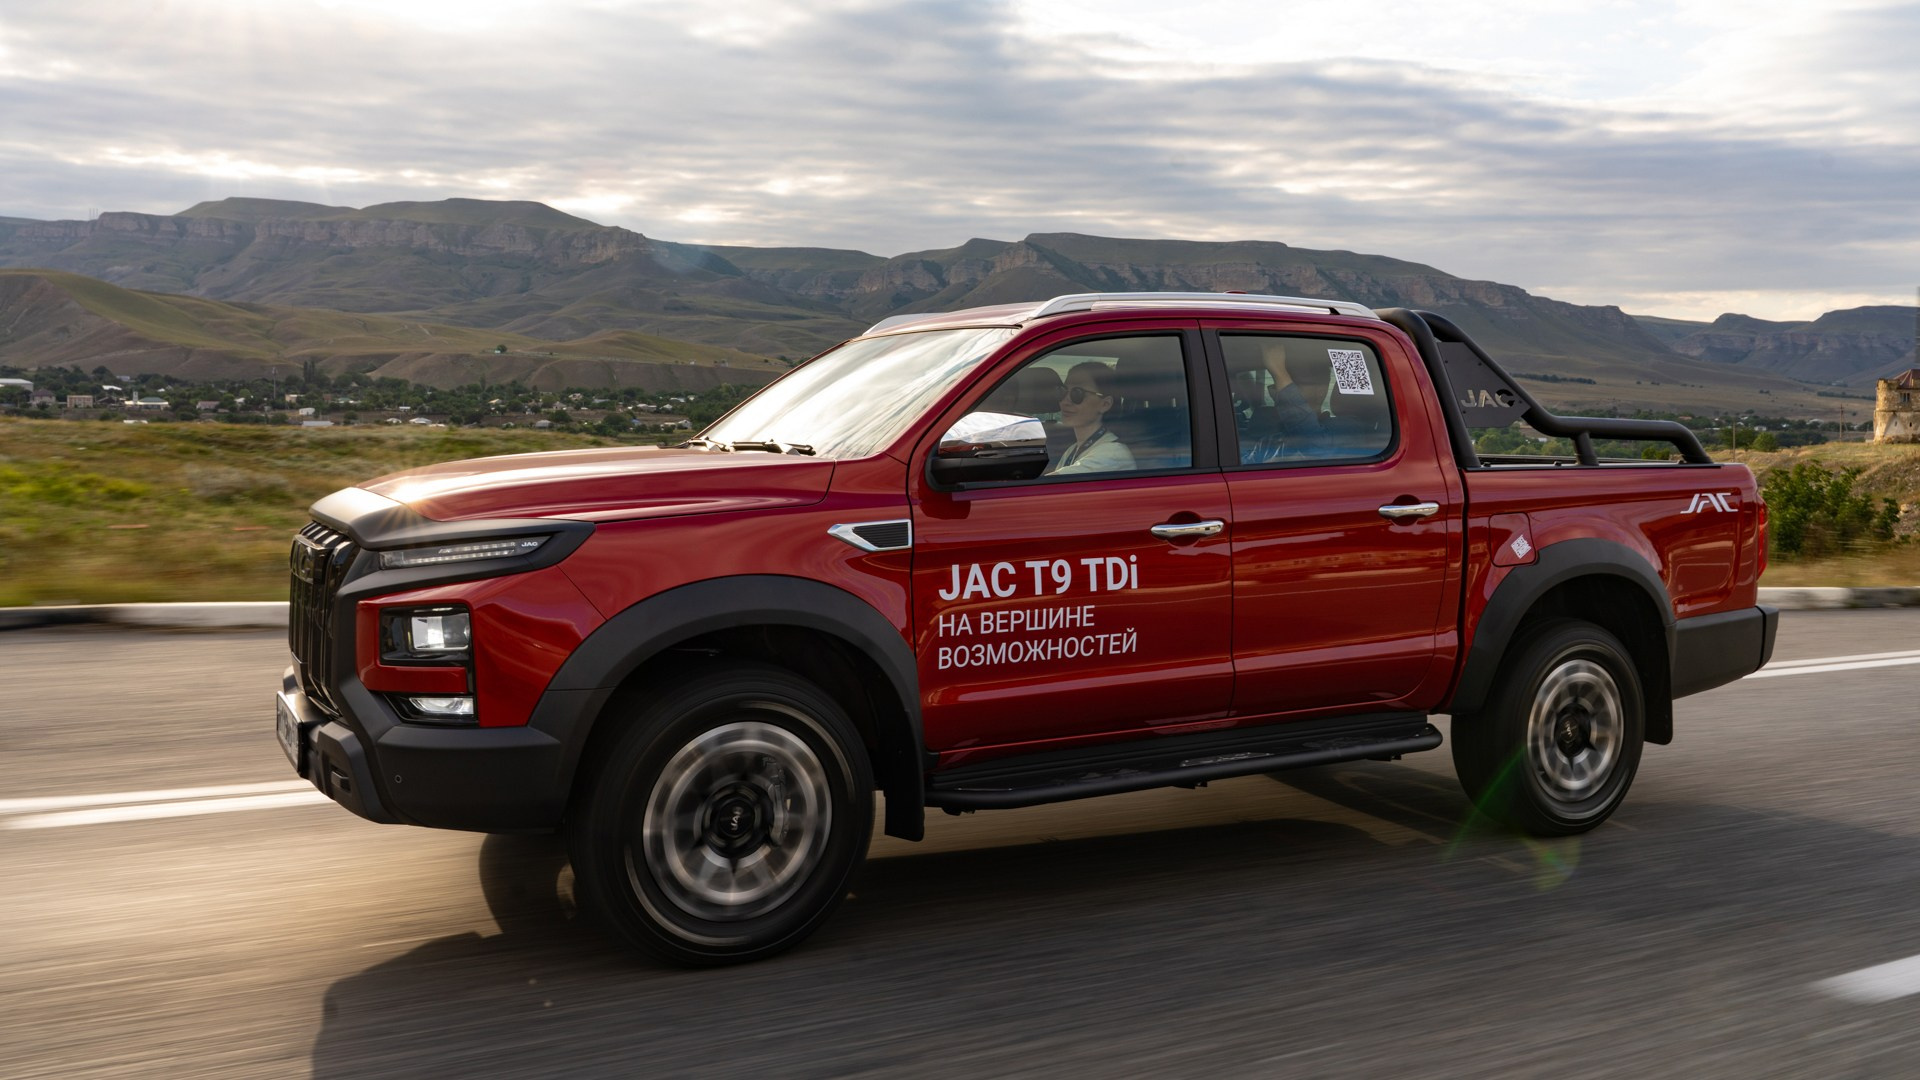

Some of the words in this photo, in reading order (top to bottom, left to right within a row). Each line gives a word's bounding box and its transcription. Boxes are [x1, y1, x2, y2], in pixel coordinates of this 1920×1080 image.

[1461, 389, 1515, 408] JAC
[1680, 492, 1738, 514] JAC
[939, 562, 1016, 600] JAC
[1025, 559, 1072, 596] T9
[1080, 554, 1138, 592] TDi
[938, 613, 973, 638] НА
[980, 605, 1095, 635] ВЕРШИНЕ
[938, 628, 1137, 669] ВОЗМОЖНОСТЕЙ
